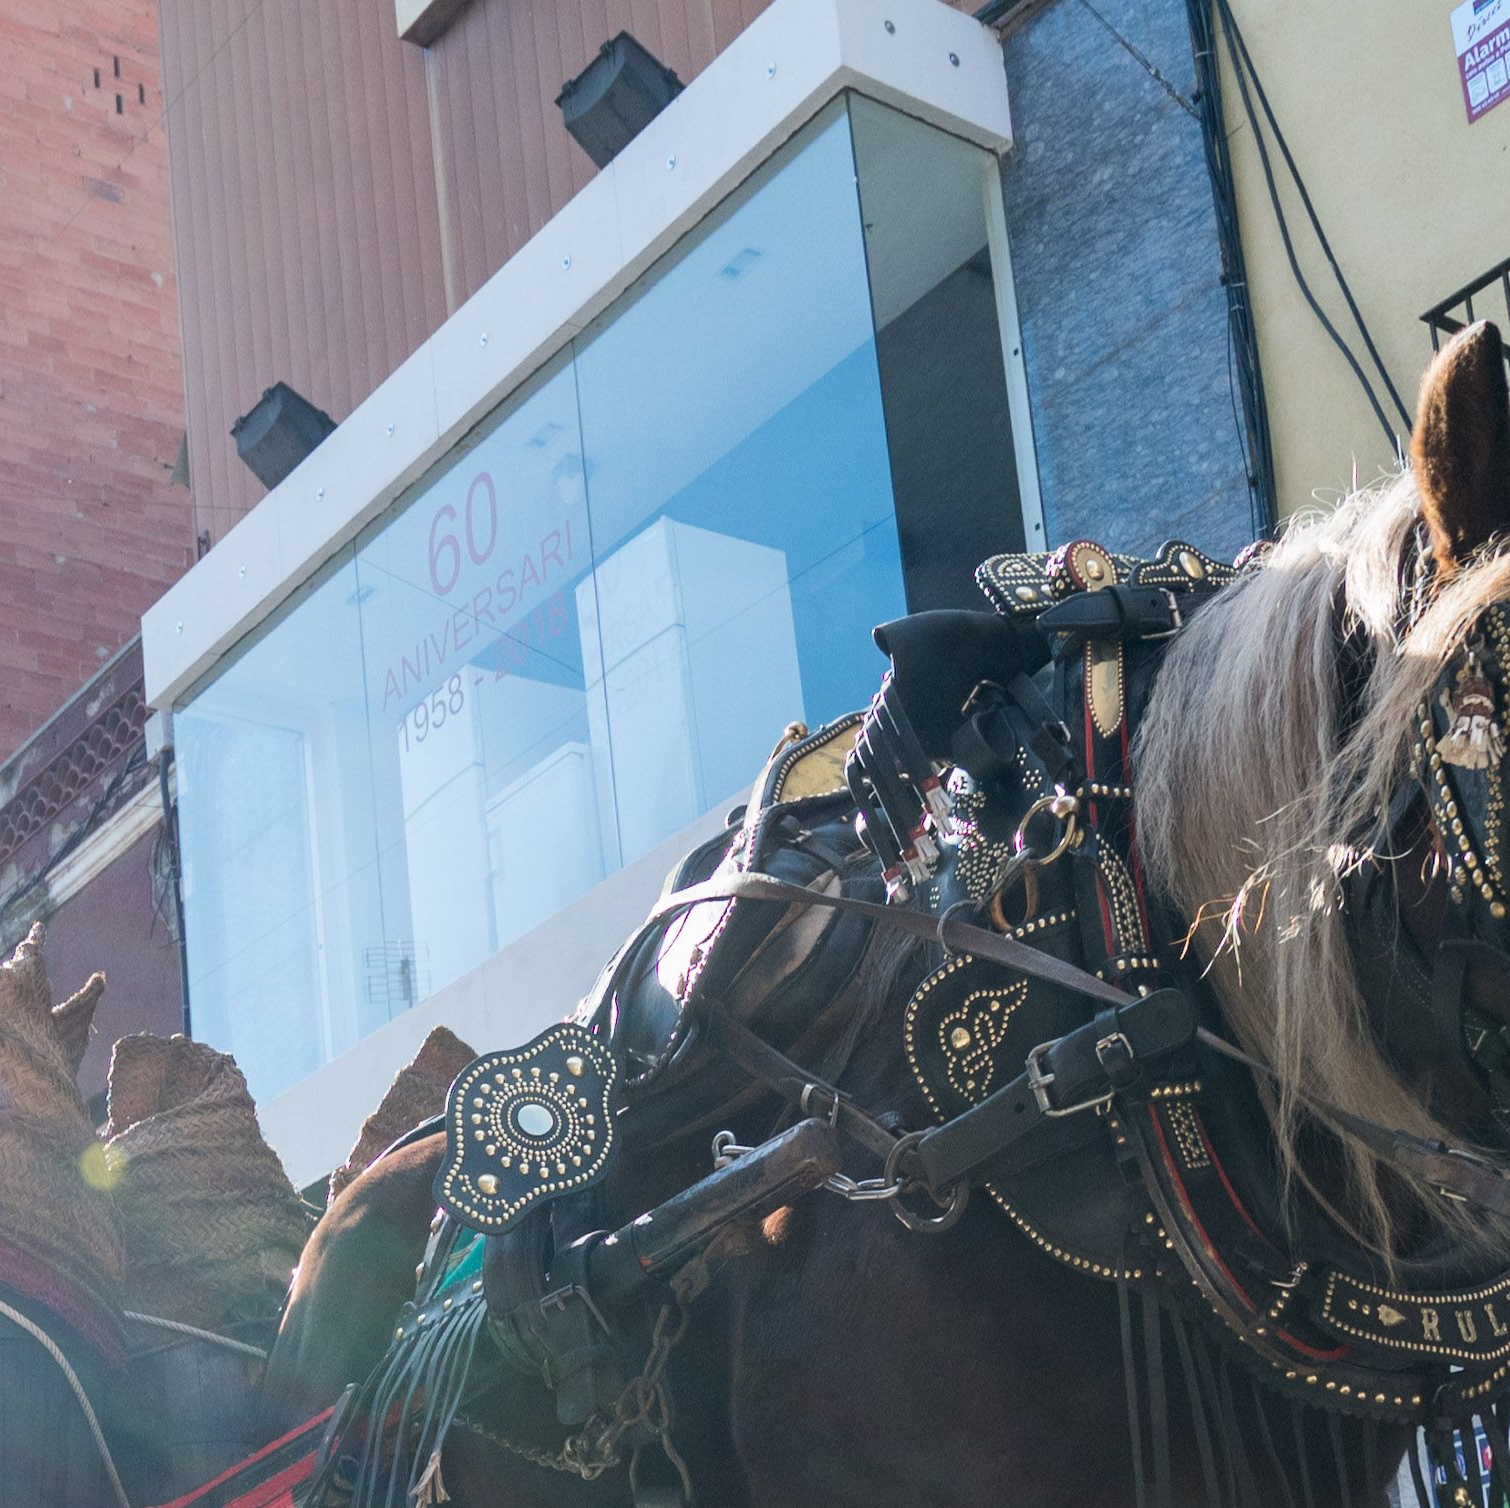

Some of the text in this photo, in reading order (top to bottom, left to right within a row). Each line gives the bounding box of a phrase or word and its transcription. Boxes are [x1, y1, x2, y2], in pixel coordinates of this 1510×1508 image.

[427, 471, 498, 597] 60
[382, 518, 574, 714] ANIVERSARI
[398, 672, 465, 753] 1958
[493, 590, 570, 684] 2018
